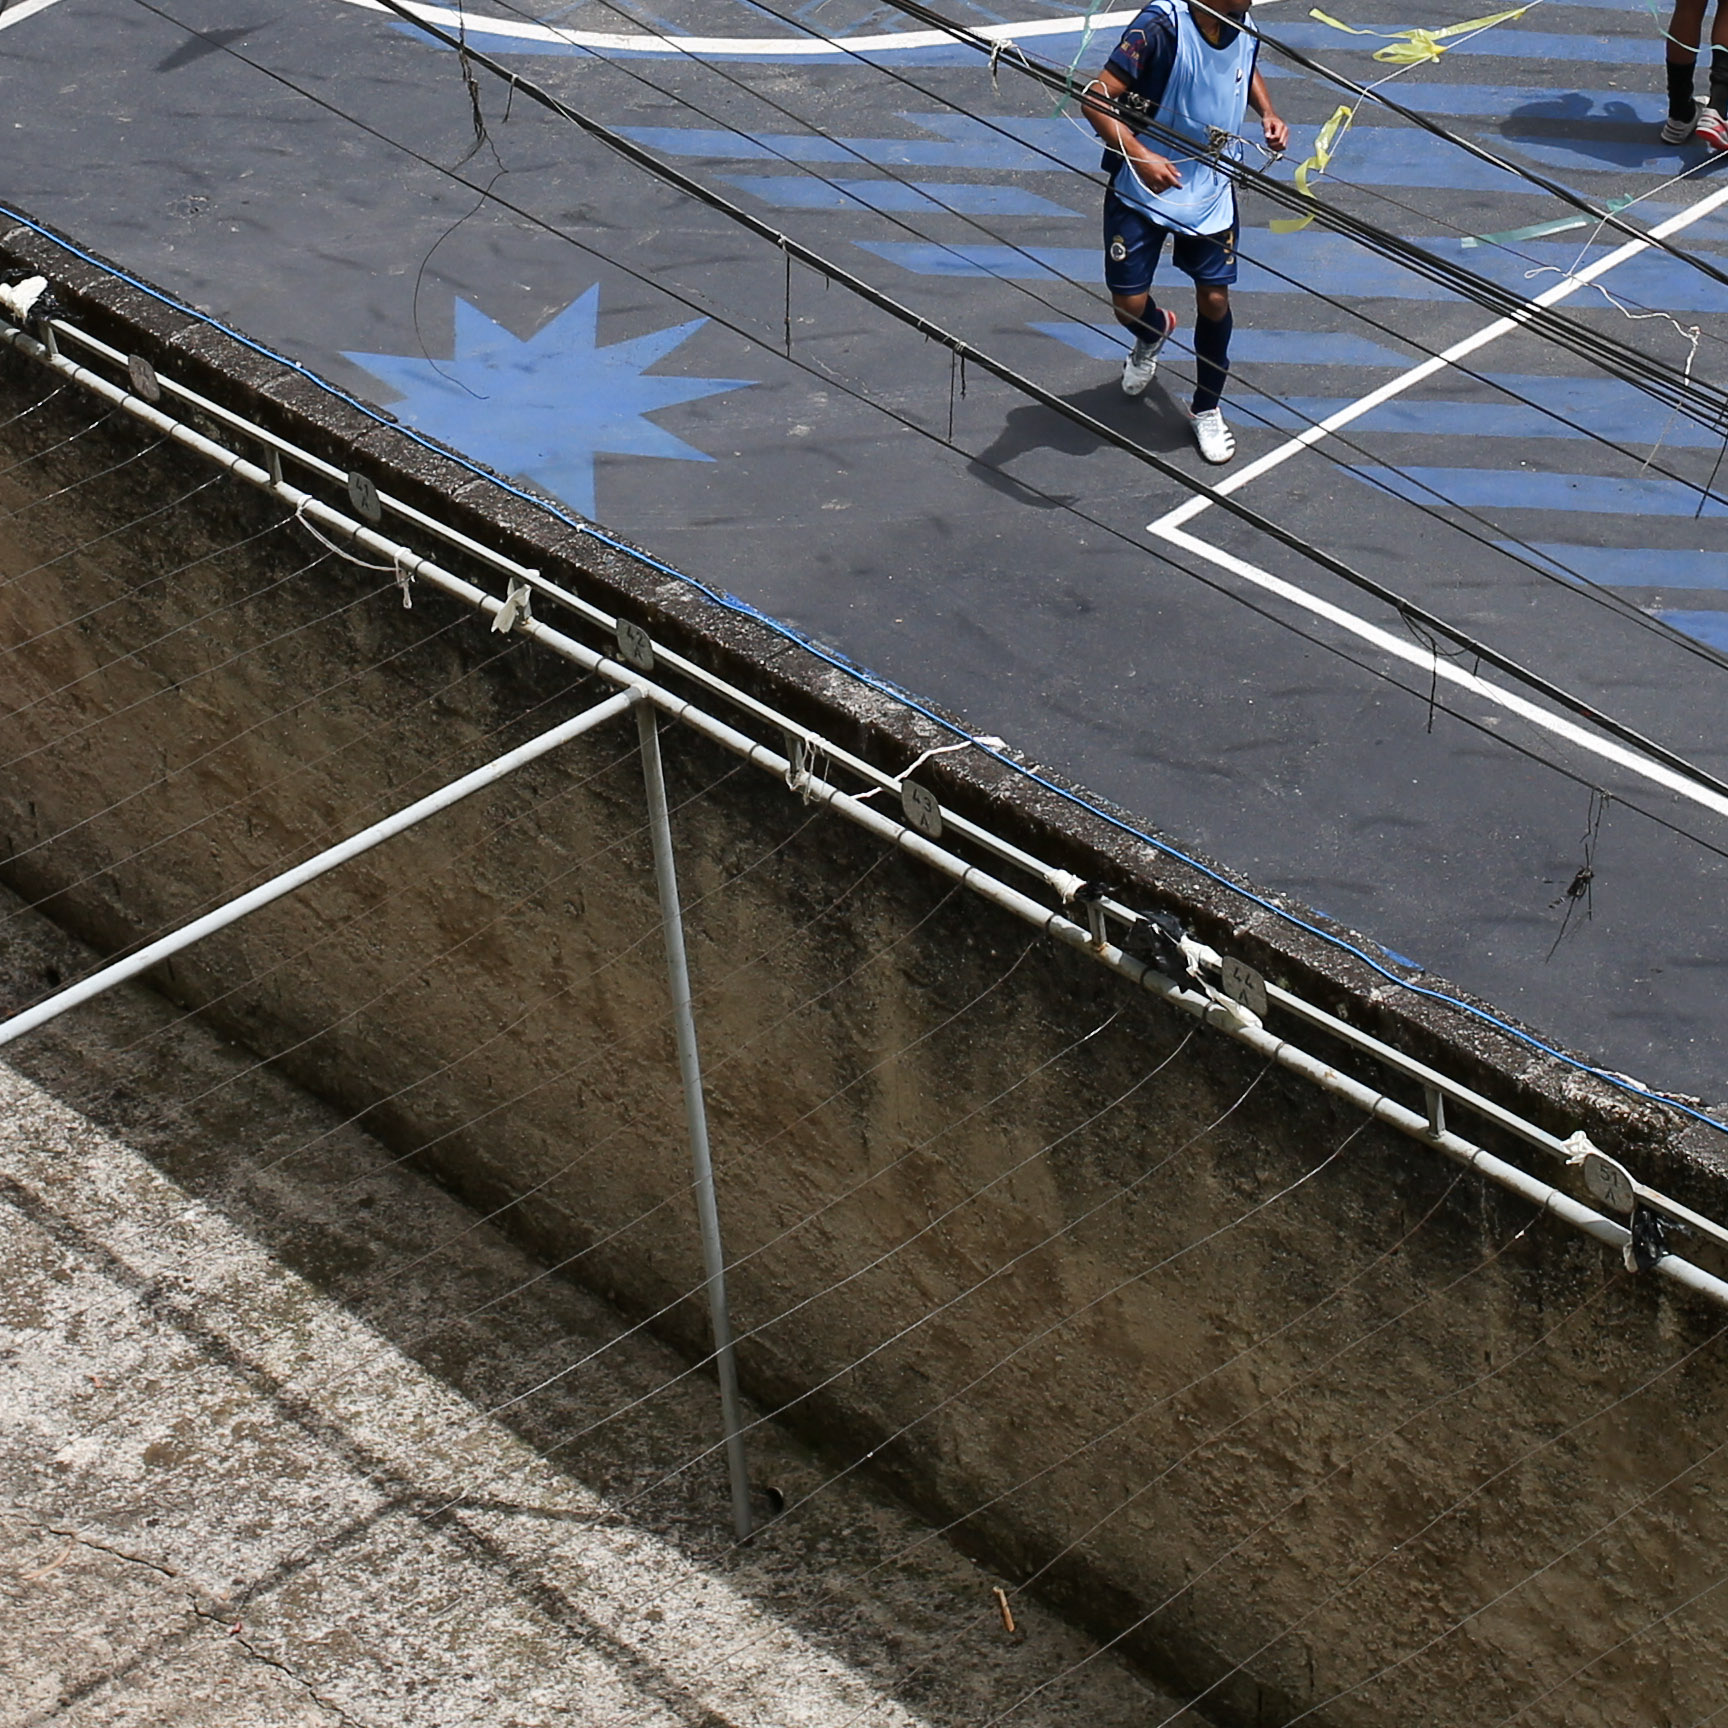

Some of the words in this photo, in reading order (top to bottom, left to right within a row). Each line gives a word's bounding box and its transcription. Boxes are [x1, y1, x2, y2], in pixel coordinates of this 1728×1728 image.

[355, 478, 369, 498] 41
[626, 625, 645, 648] 42
[912, 788, 933, 814] 43
[1233, 966, 1255, 990] 44
[1599, 1164, 1620, 1189] 51
